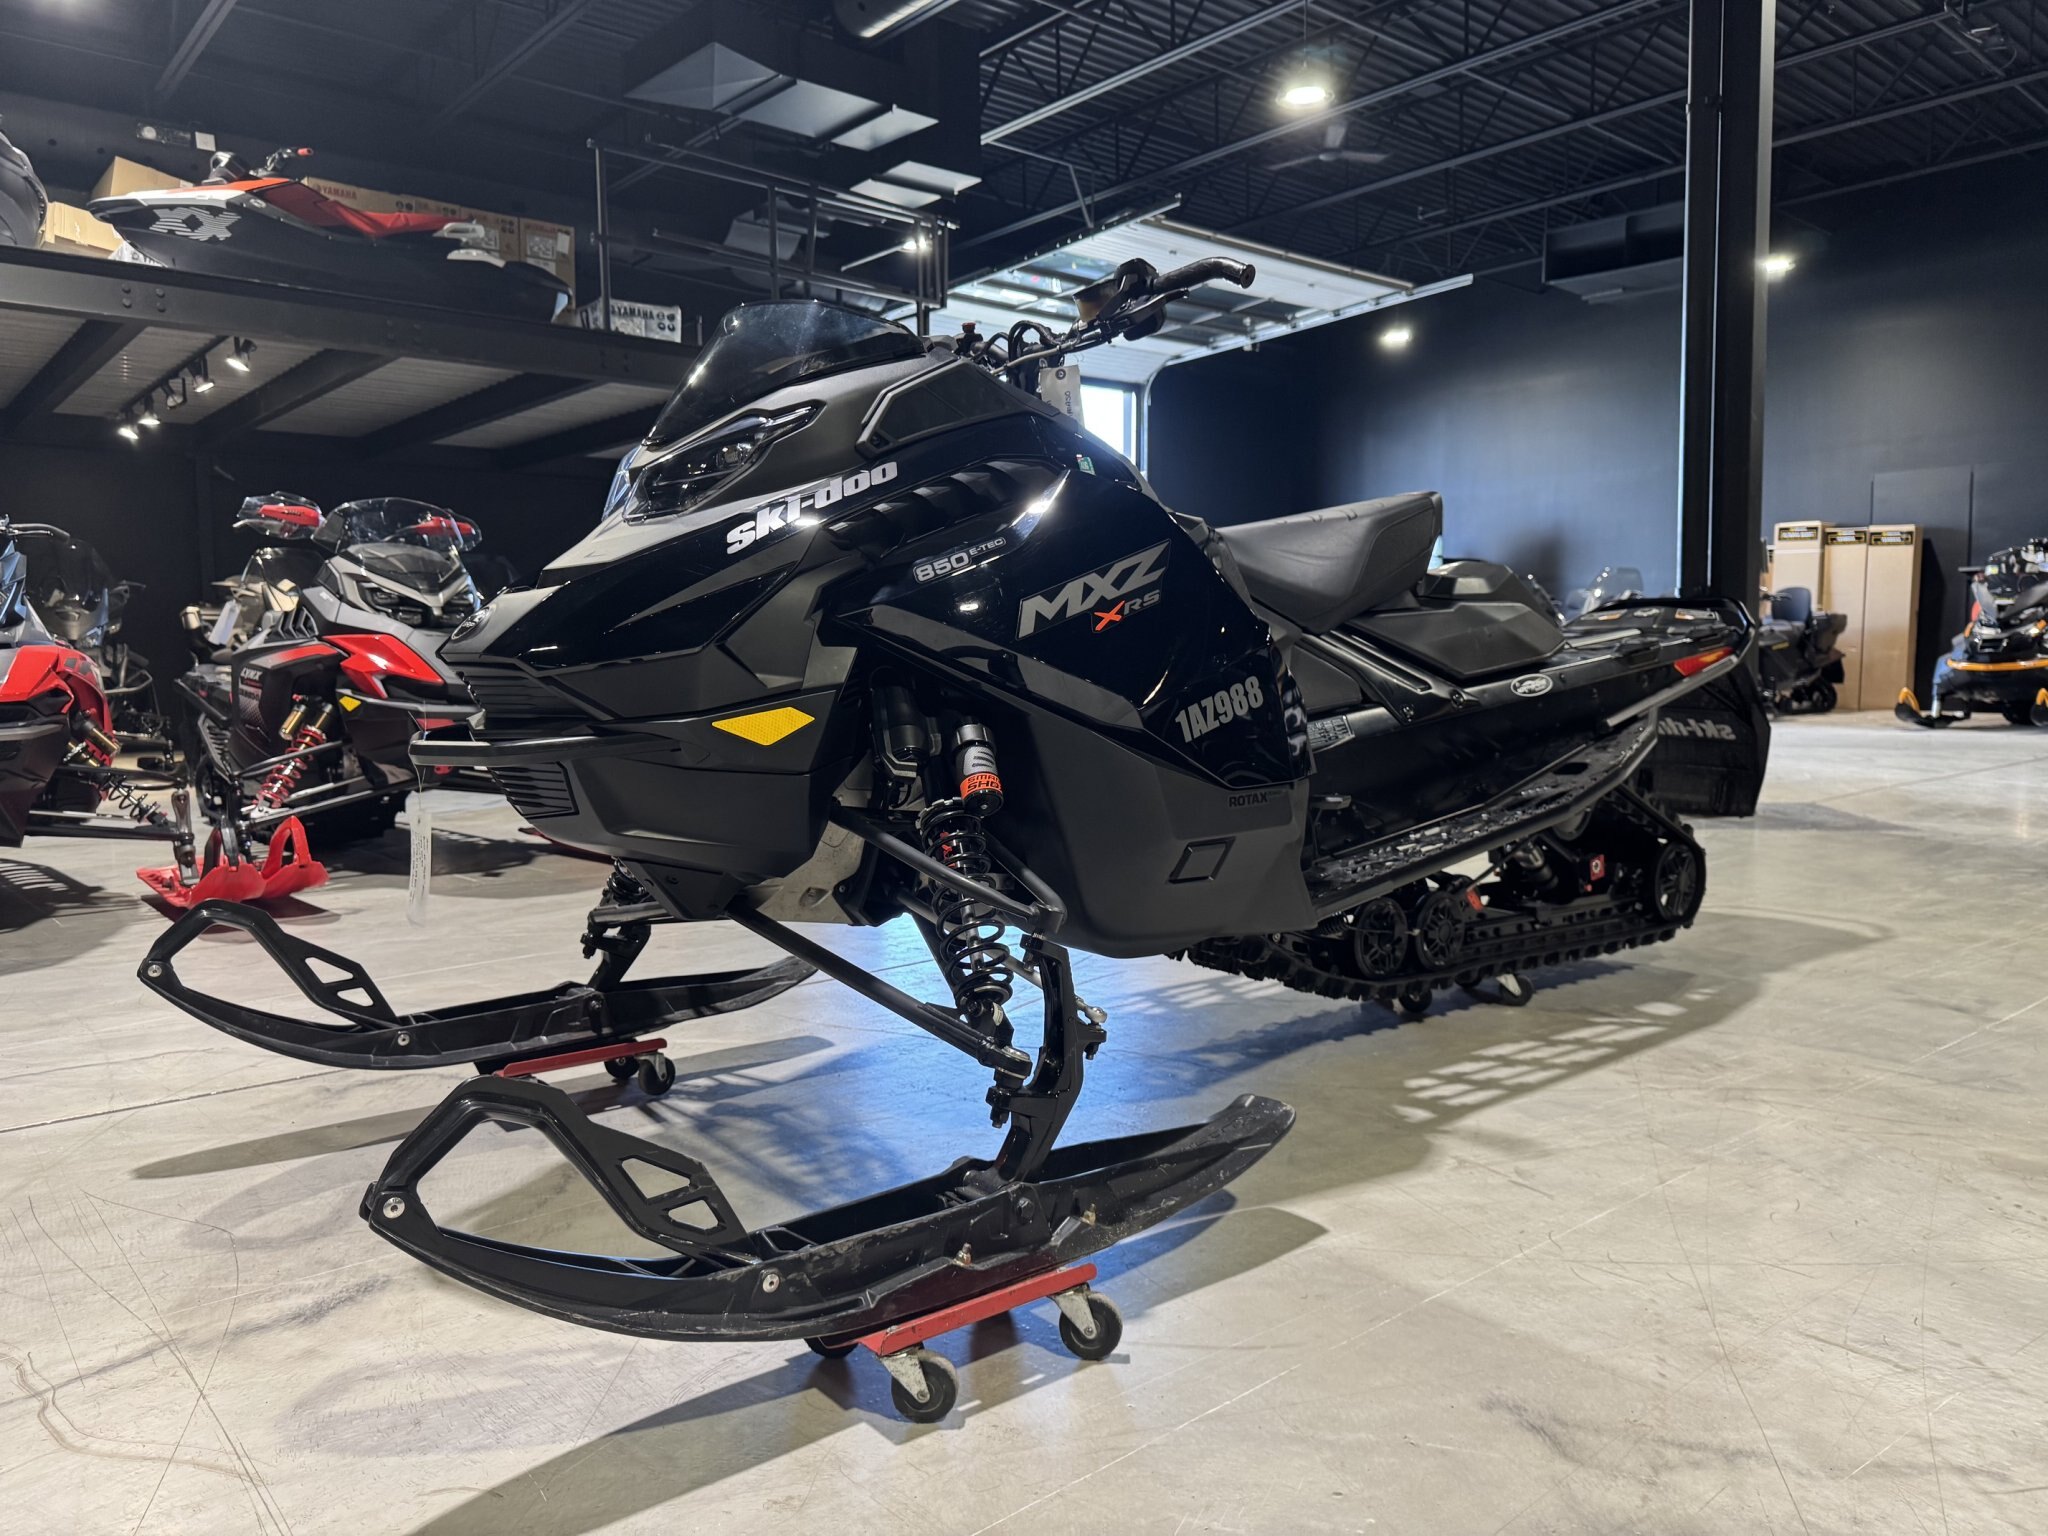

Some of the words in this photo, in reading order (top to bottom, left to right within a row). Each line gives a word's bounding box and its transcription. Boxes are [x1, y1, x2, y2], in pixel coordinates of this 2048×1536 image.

[323, 186, 357, 200] YAMAHA
[617, 305, 655, 321] YAMAHA
[726, 461, 898, 555] ski-doo
[915, 551, 969, 582] 850
[968, 538, 1004, 556] E-TEC
[1018, 541, 1170, 639] MXZ
[1174, 675, 1264, 743] 1AZ988
[1228, 791, 1269, 808] ROTAX
